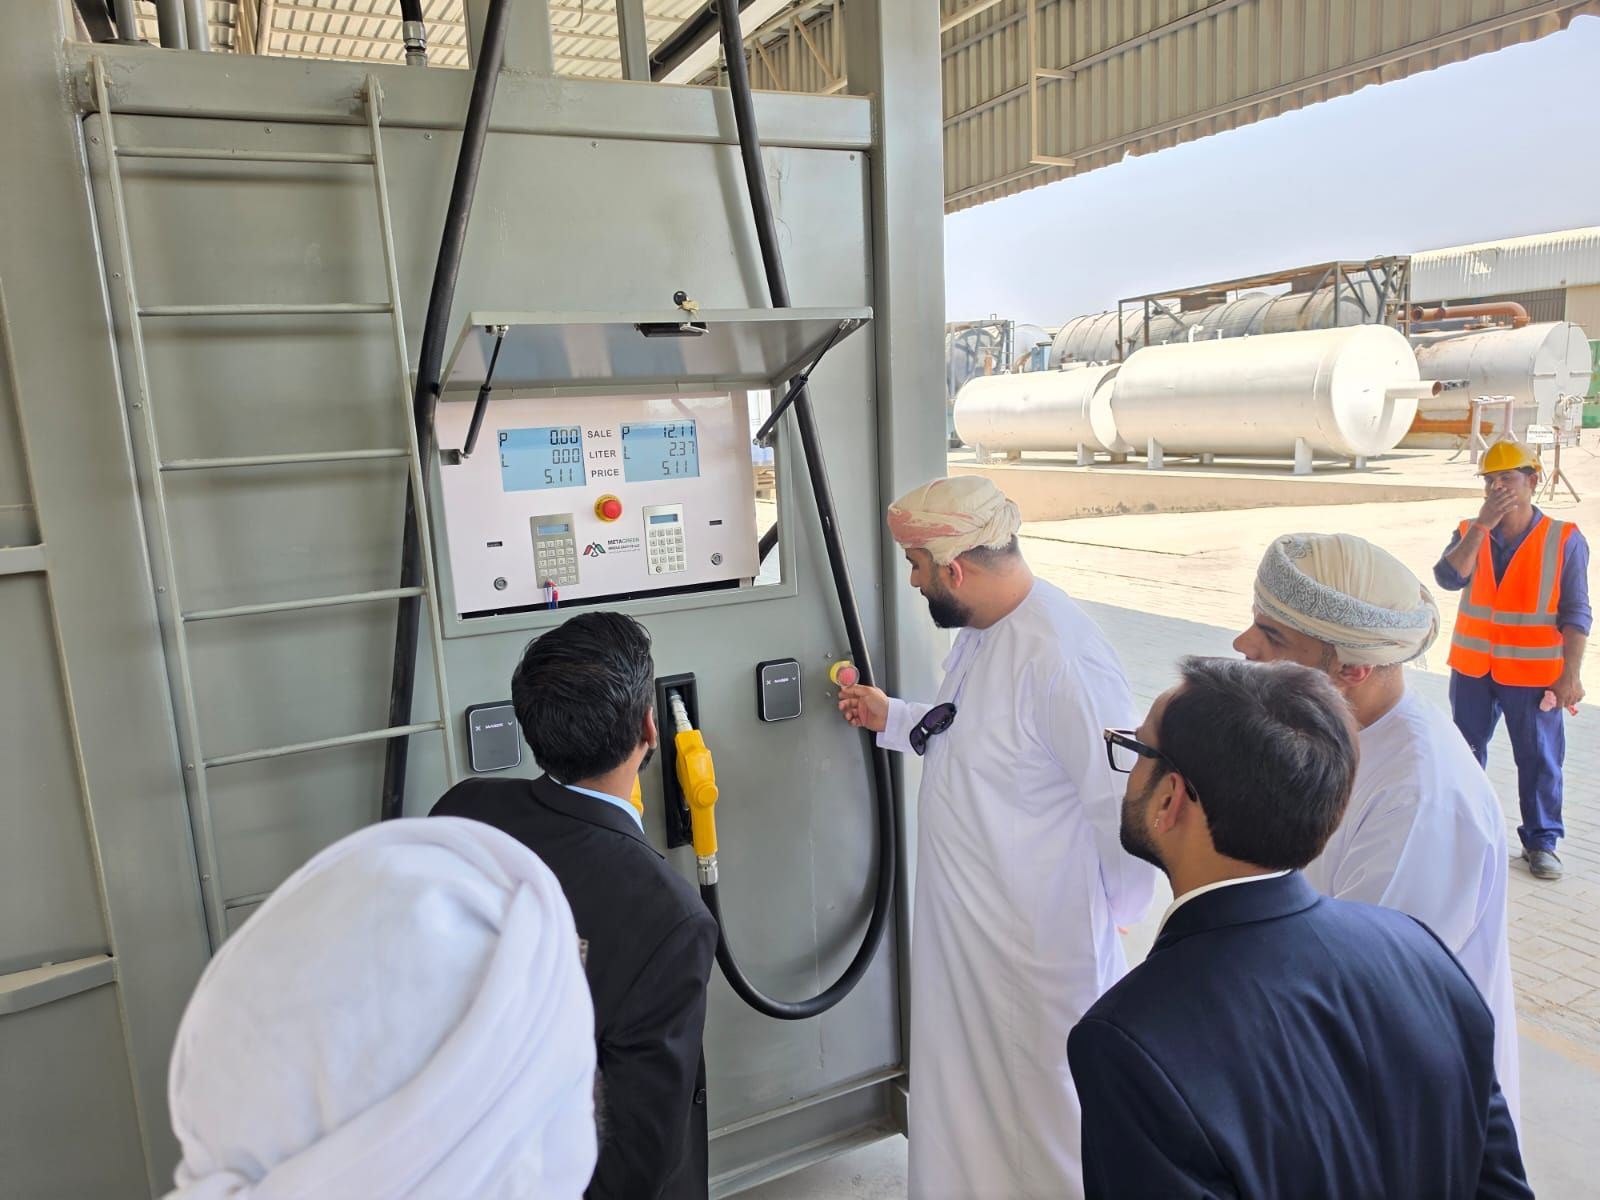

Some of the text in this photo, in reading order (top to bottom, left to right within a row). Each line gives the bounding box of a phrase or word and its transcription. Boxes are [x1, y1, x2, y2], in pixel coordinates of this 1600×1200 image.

[587, 429, 613, 439] SALE
[621, 425, 630, 441] P
[499, 432, 508, 448] P
[589, 449, 617, 459] LITER
[591, 468, 620, 478] PRICE
